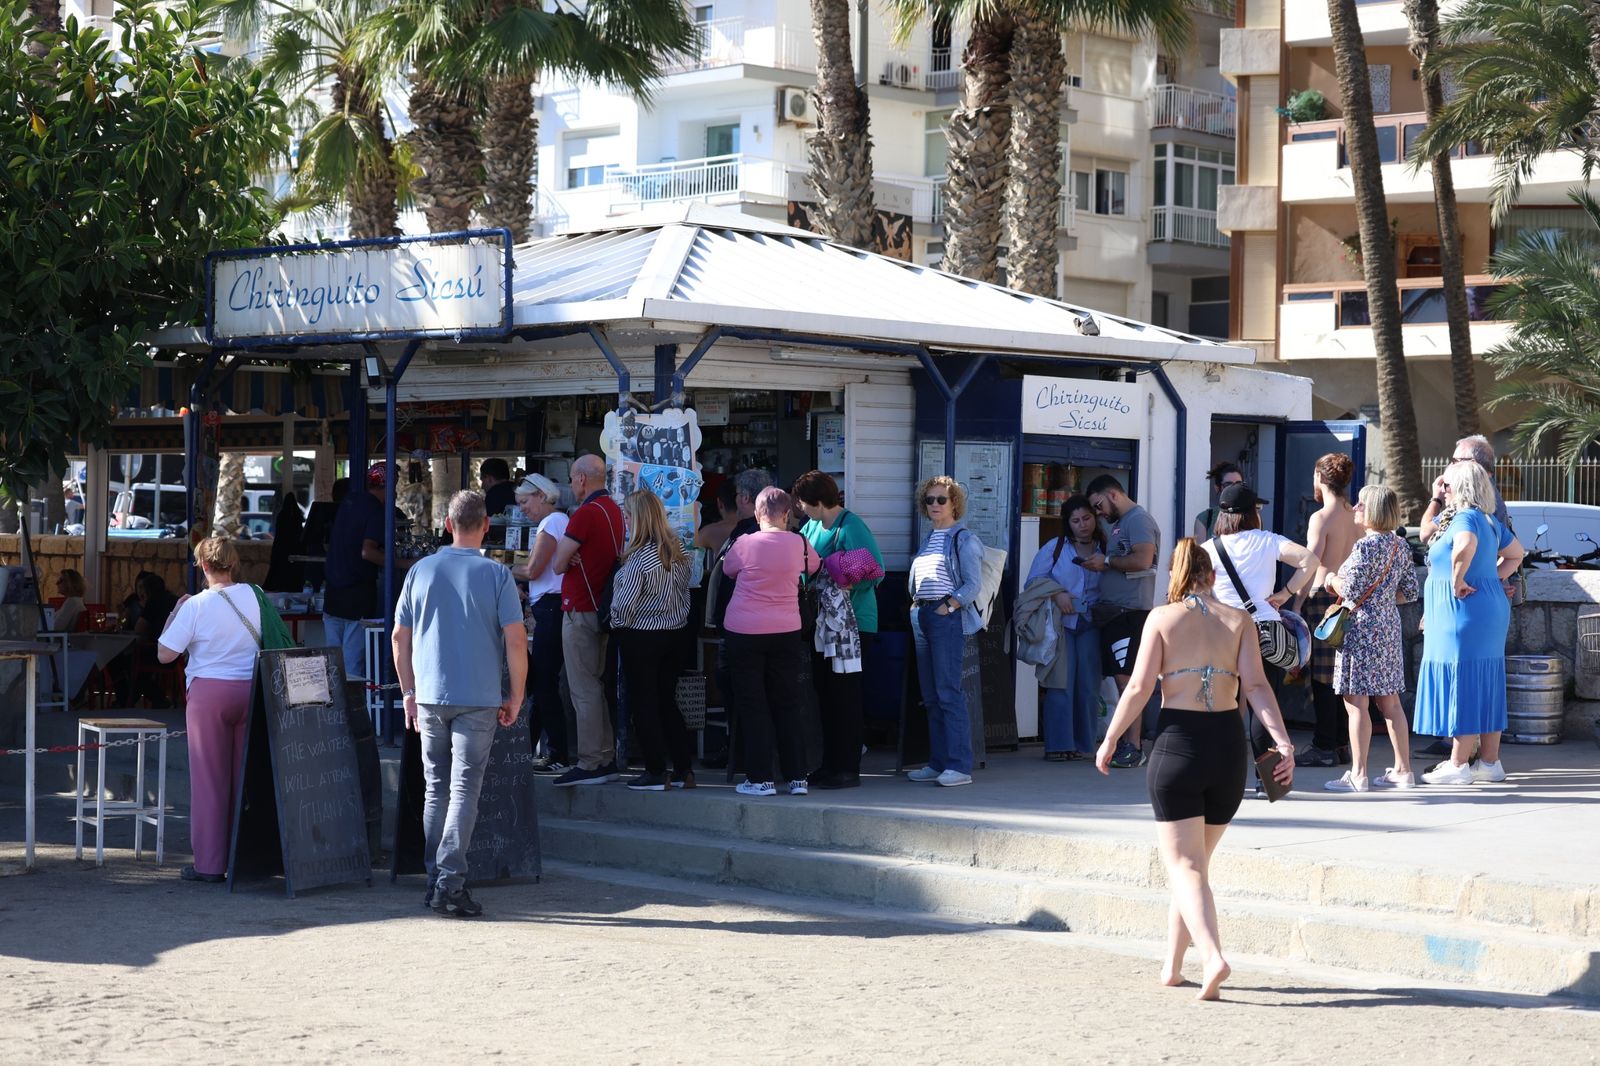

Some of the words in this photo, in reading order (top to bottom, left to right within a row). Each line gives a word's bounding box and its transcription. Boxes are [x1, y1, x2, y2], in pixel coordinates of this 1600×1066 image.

[228, 266, 381, 324] Chiringuito
[395, 259, 486, 303] Sicsú
[1036, 383, 1130, 414] Chiringuito
[1058, 410, 1109, 431] Sicsú
[276, 708, 305, 734] WAIT
[281, 741, 306, 765] THE
